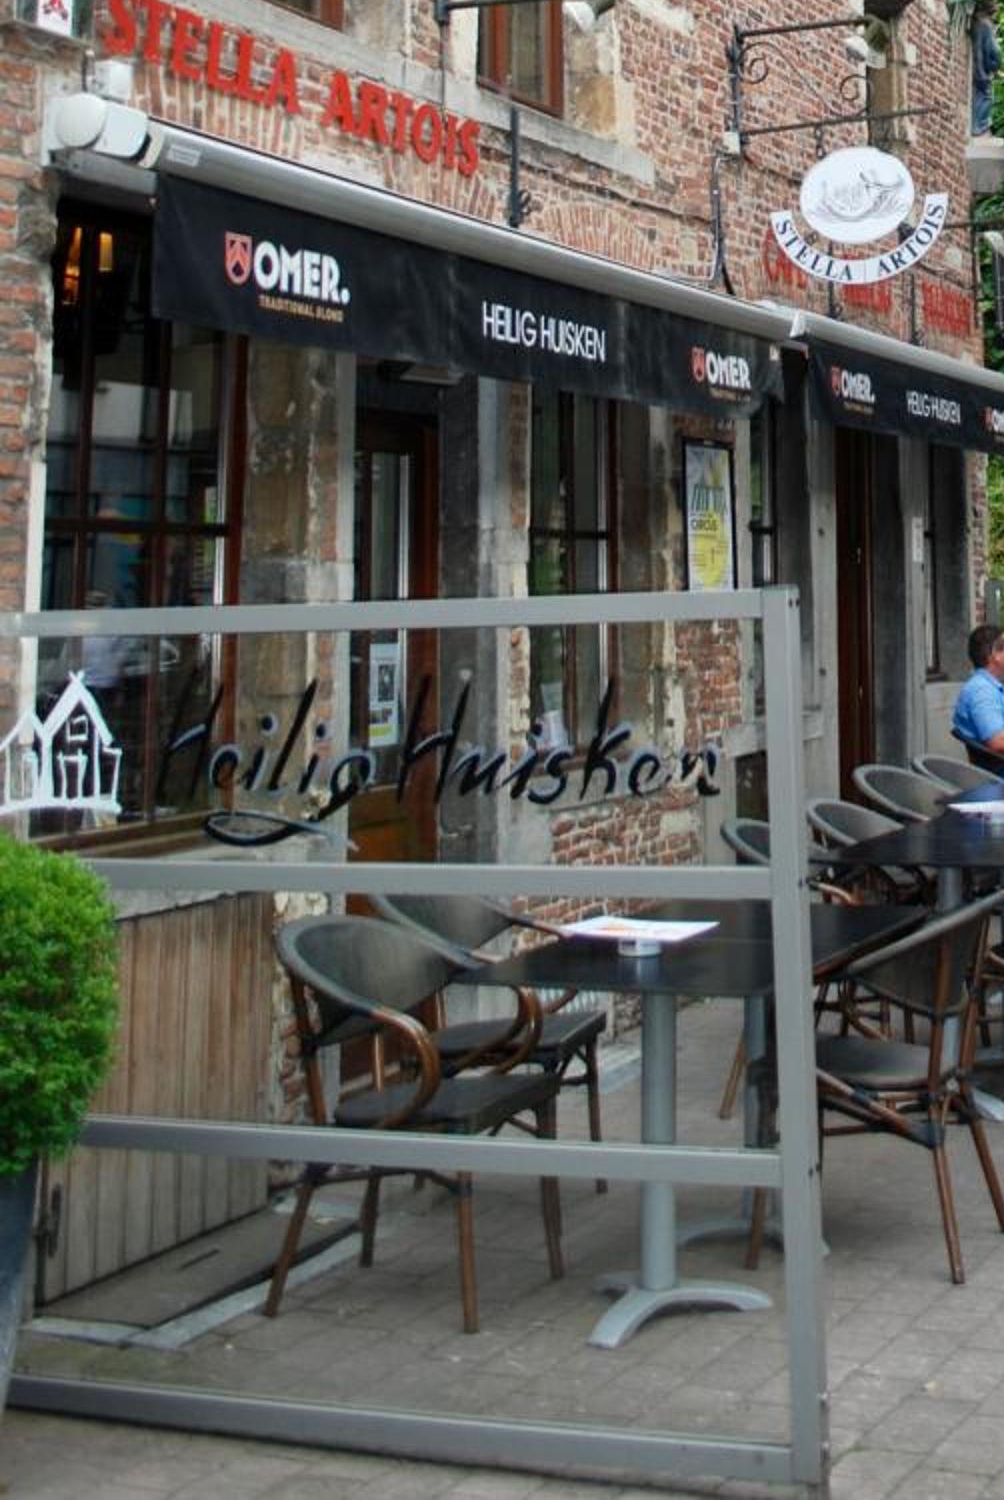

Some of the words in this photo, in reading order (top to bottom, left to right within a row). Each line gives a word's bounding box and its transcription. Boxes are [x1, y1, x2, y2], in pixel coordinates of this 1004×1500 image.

[320, 68, 481, 178] ARTOIS
[254, 240, 350, 305] OMER.
[775, 217, 852, 281] STELLA
[876, 203, 945, 278] ARTOIS
[481, 300, 538, 348] HEILIG
[540, 314, 606, 363] HUISKEN
[156, 665, 375, 848] Heilig
[397, 673, 721, 804] Huisken
